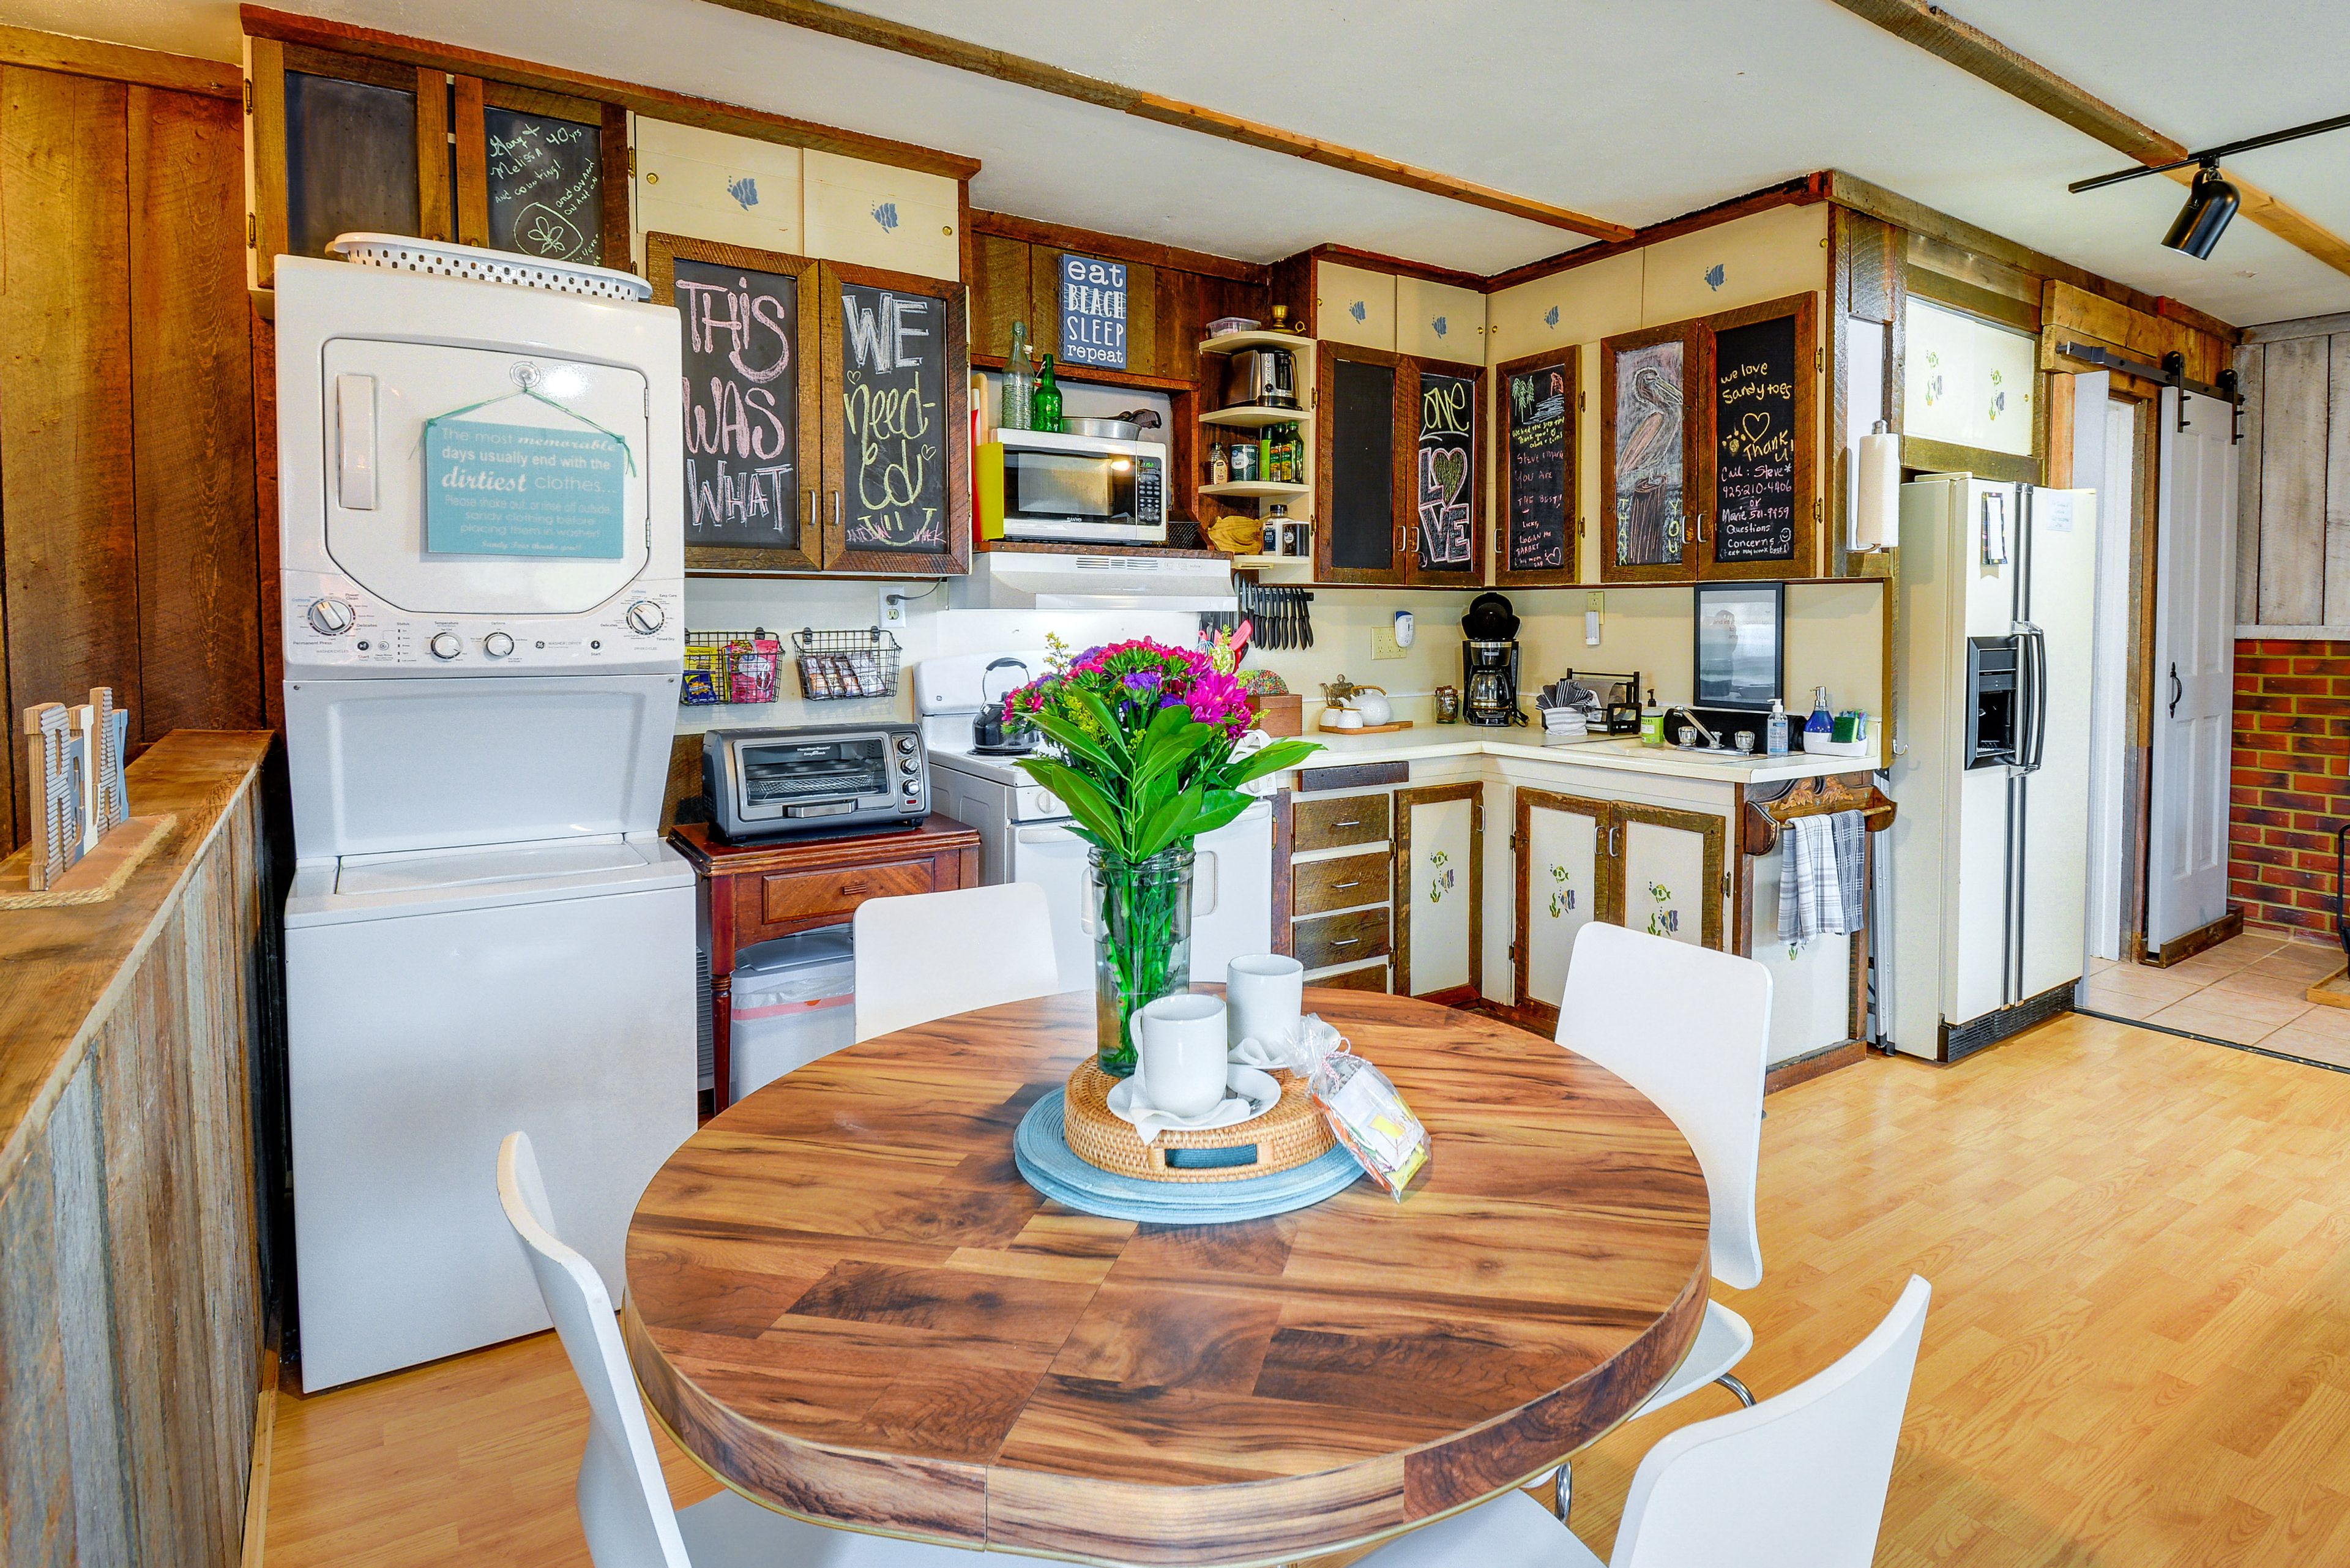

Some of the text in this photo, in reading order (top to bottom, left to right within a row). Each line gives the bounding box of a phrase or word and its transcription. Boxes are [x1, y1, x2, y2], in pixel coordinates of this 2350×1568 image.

[546, 127, 569, 145] 40
[1067, 260, 1124, 288] eat
[1067, 283, 1126, 319] BEACH
[841, 292, 930, 375] WE
[1067, 316, 1124, 347] SLEEP
[1067, 344, 1124, 364] repeat
[1721, 362, 1768, 384] we love
[1767, 383, 1792, 399] toes
[682, 377, 786, 460] WAS
[442, 428, 617, 452] The most memorable
[1743, 430, 1788, 462] Thank
[442, 446, 611, 471] days usually end with the
[441, 465, 527, 493] dirtiest
[687, 458, 794, 534] WHAT
[1750, 498, 1762, 507] or
[1726, 523, 1771, 534] Questions
[1728, 537, 1775, 548] Concerns
